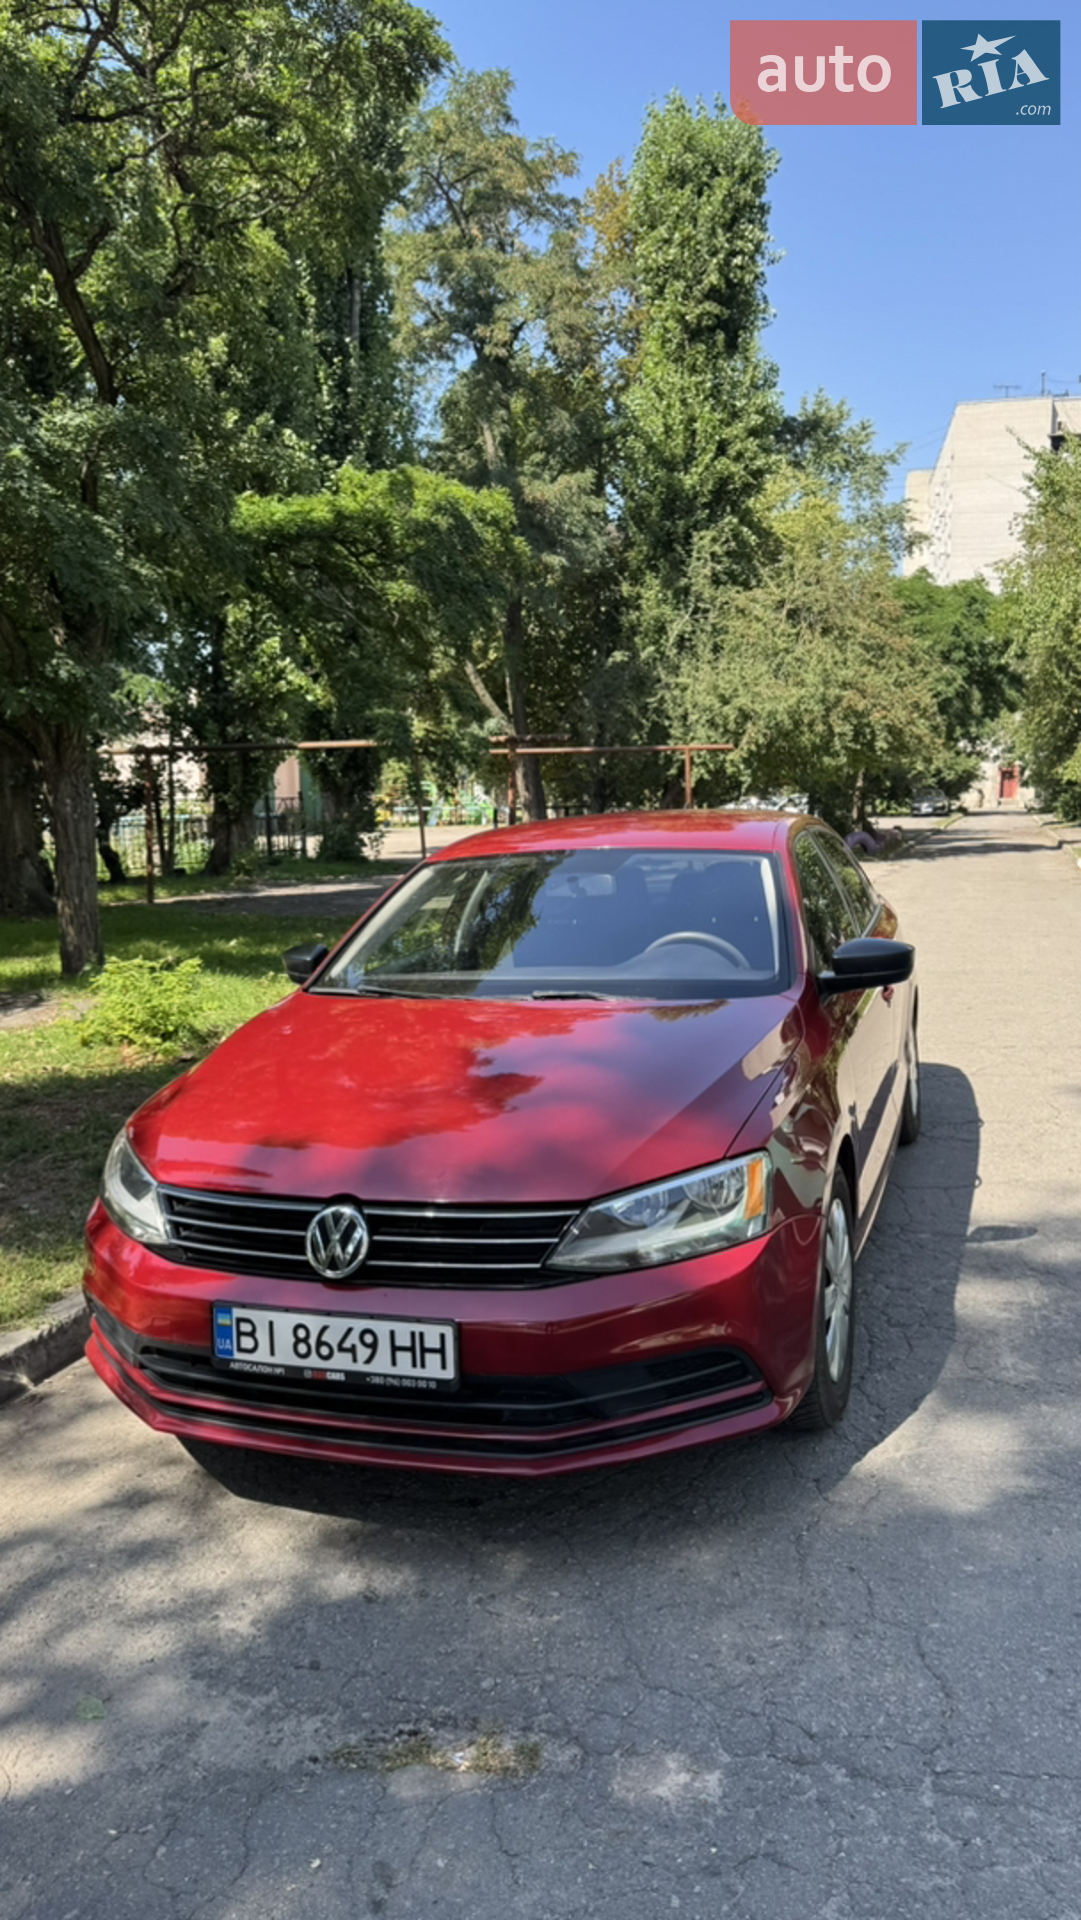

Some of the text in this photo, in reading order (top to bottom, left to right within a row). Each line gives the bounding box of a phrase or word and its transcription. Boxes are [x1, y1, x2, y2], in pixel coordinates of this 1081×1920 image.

[217, 1338, 232, 1350] UA
[235, 1317, 447, 1370] BI 8649 HH
